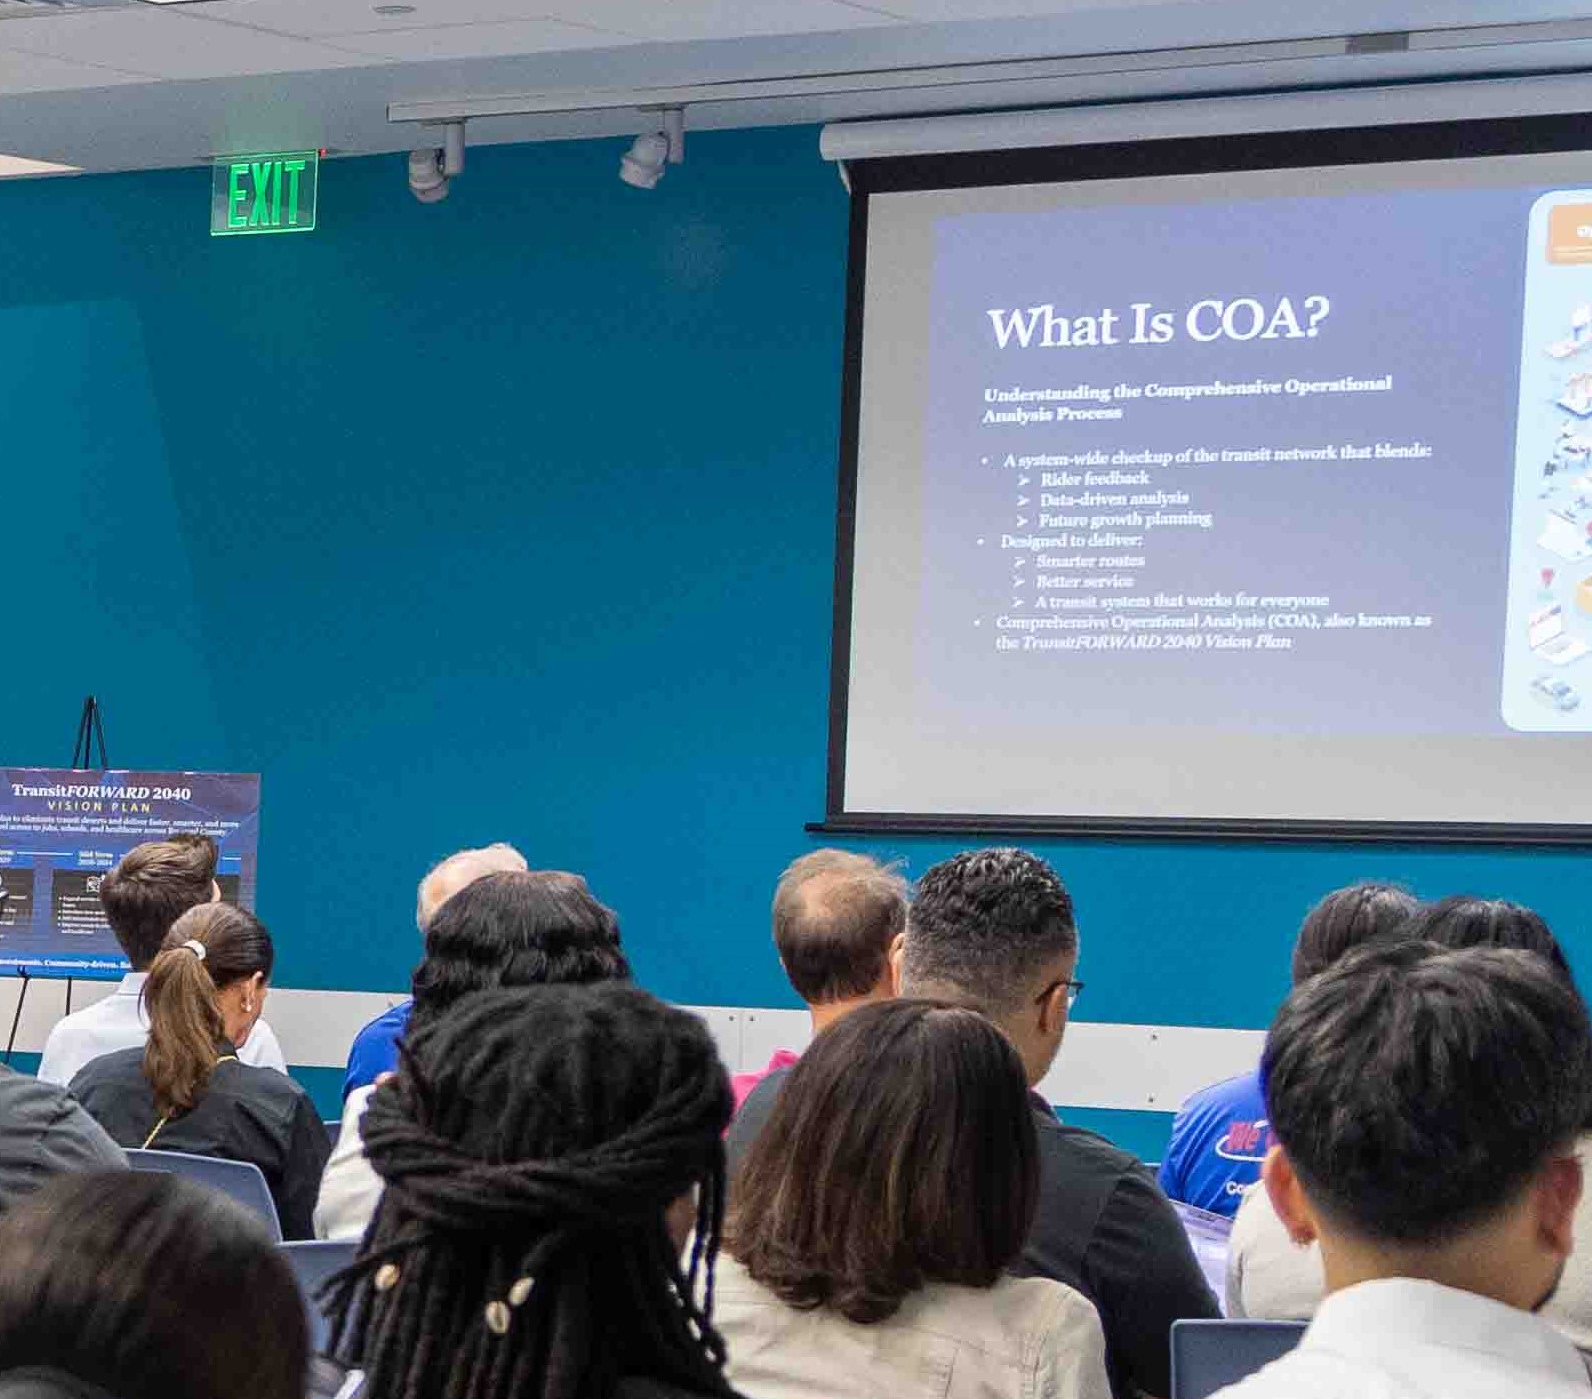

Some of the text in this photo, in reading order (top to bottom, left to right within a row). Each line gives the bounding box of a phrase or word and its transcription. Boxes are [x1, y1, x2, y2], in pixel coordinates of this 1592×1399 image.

[227, 159, 306, 228] EXIT
[986, 295, 1330, 349] What Is COA?
[984, 374, 1393, 402] Understanding the Comprehensive Operational
[983, 406, 1123, 425] Analysis Process
[1003, 442, 1433, 469] A system-wide checkup of the transit network that blends:
[1041, 470, 1151, 487] Rider feedback
[1040, 490, 1190, 508] Data-driven analysis
[1039, 511, 1213, 529] Future growth planning
[1001, 533, 1067, 550] Designed
[1070, 534, 1085, 547] to
[1036, 555, 1146, 568] Smarter routes
[1036, 574, 1135, 589] Better service
[1049, 595, 1098, 608] transit
[1101, 595, 1151, 612] system
[1154, 592, 1185, 607] that
[1187, 592, 1232, 607] works
[1236, 590, 1258, 606] for
[1260, 596, 1330, 611] everyone
[996, 614, 1109, 632] Comprehensive
[1111, 612, 1199, 631] Operational
[1201, 612, 1266, 631] Analysis
[1323, 612, 1356, 627] also
[1358, 612, 1411, 627] known
[1413, 616, 1433, 627] as
[996, 635, 1020, 650] the
[1205, 633, 1253, 650] Vision
[1255, 633, 1293, 649] Plan
[11, 783, 191, 801] TransitFORWARD 2040
[48, 801, 151, 813] VISION PLAN
